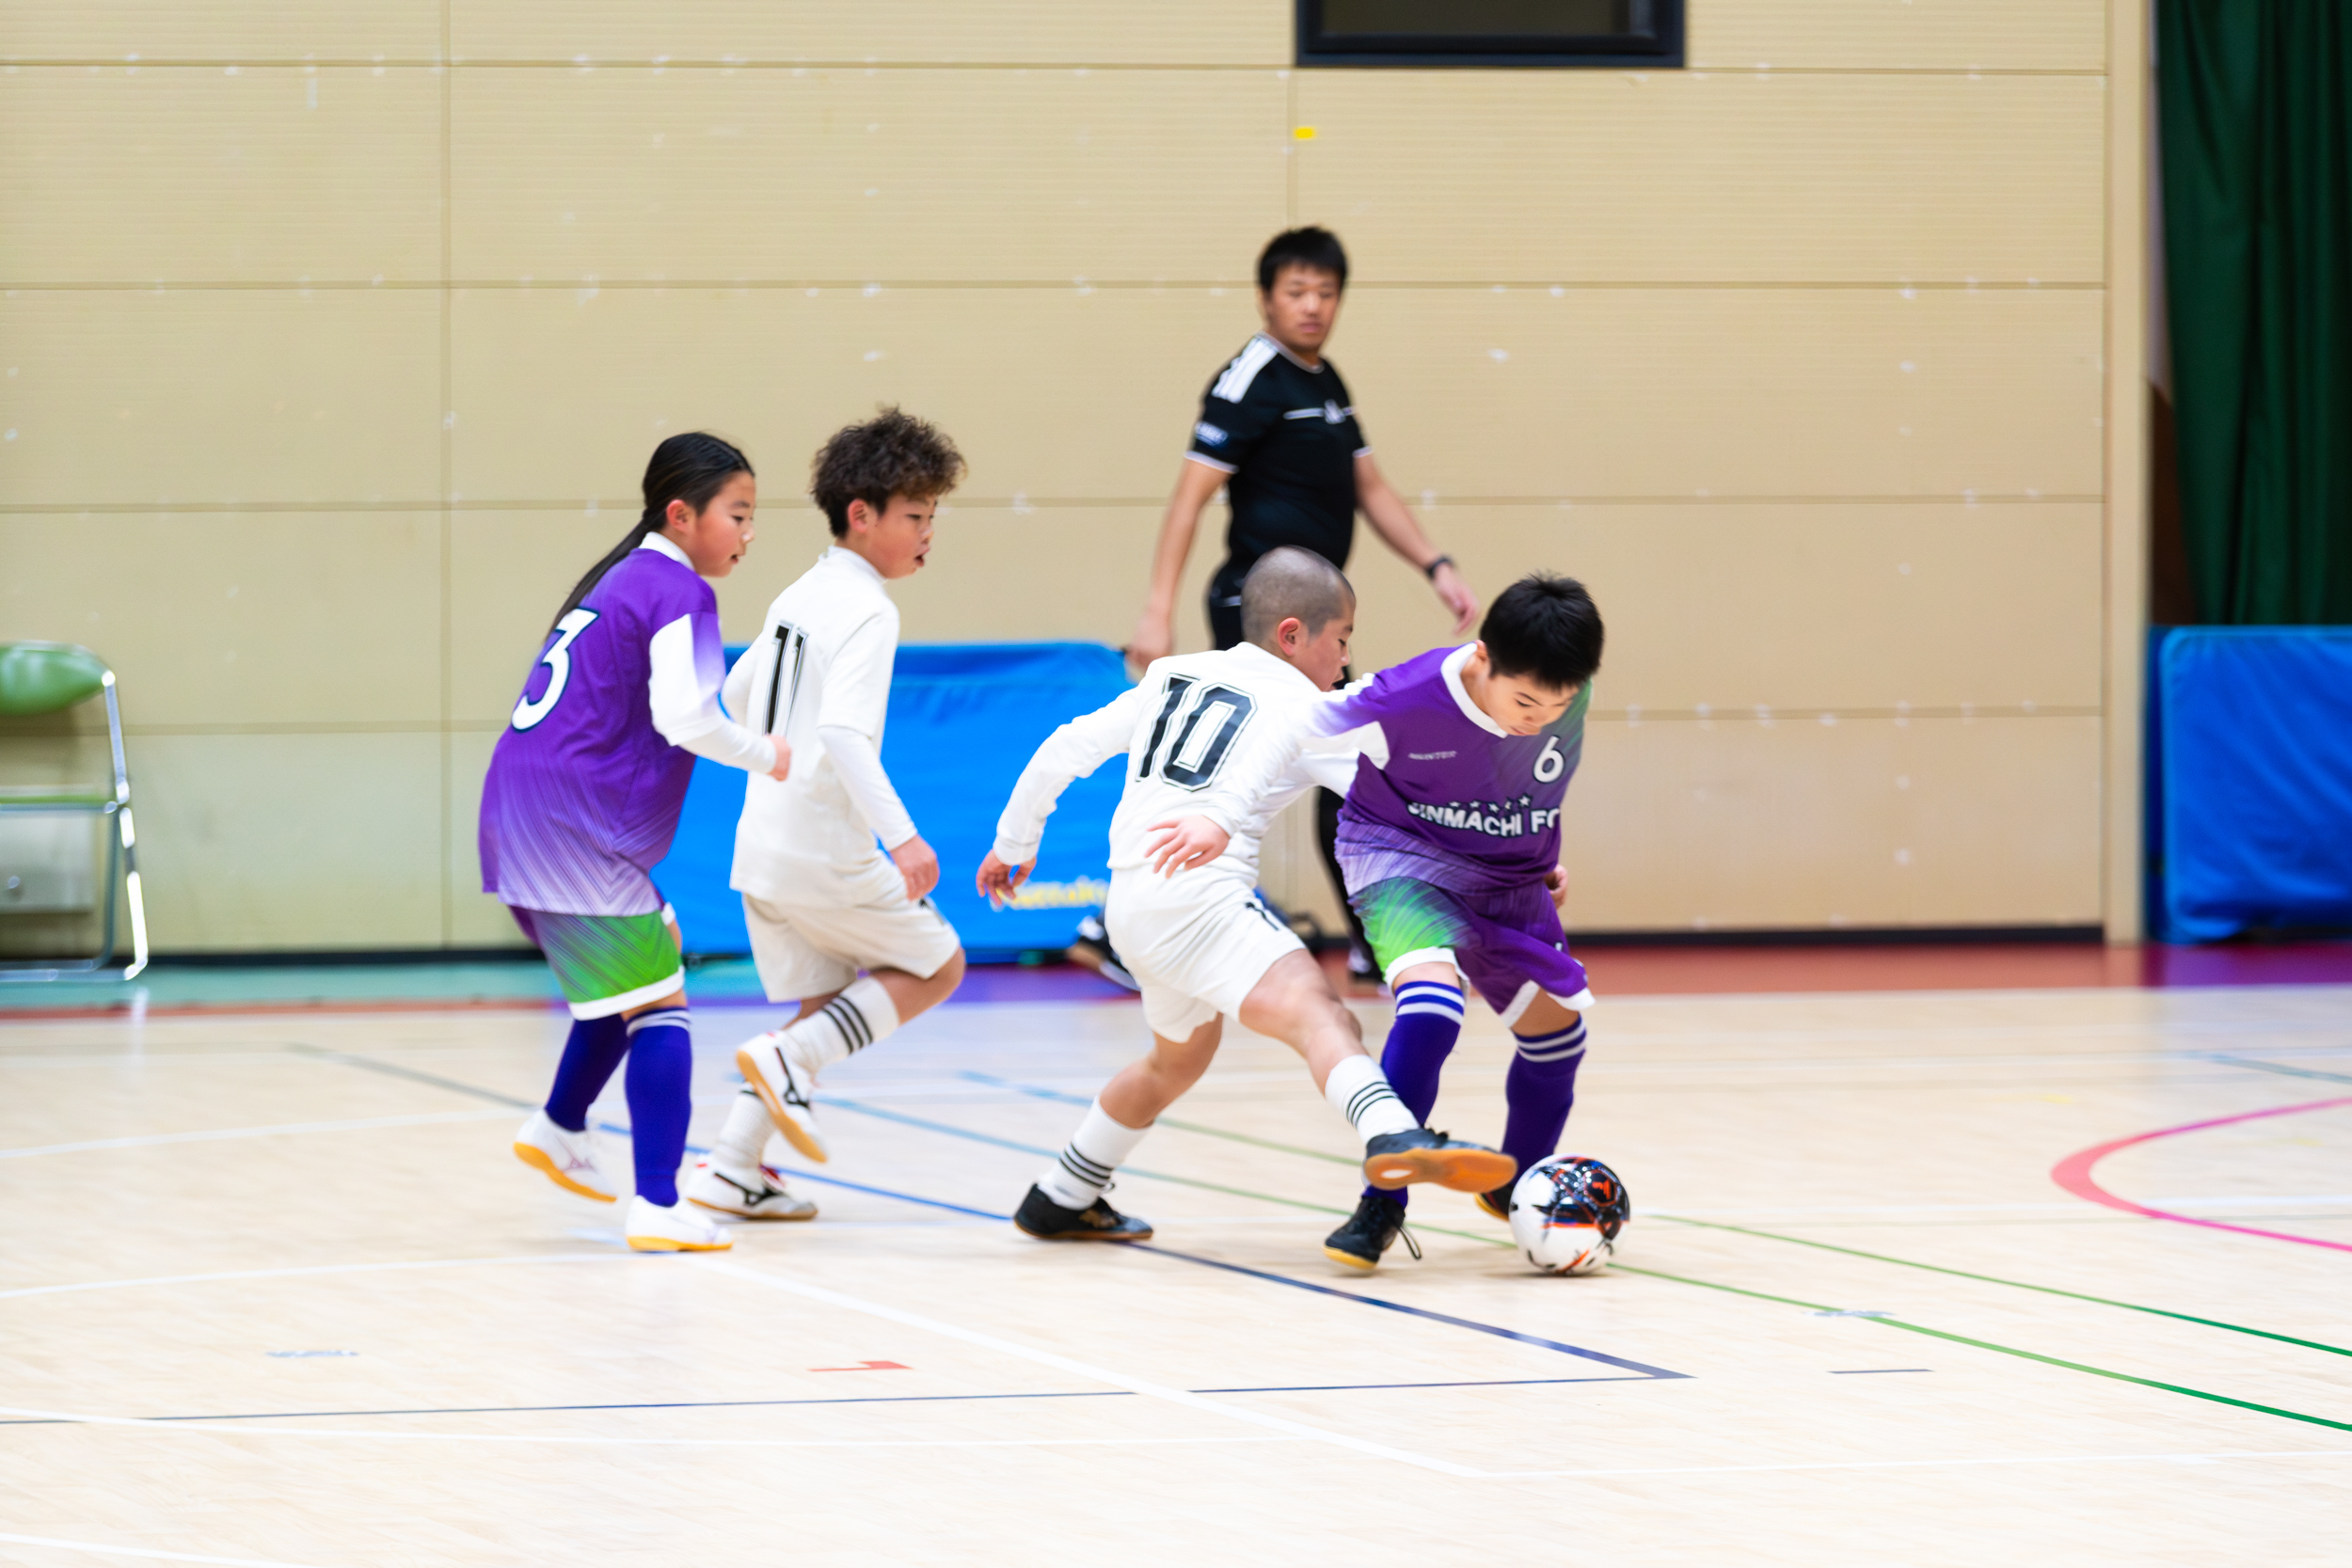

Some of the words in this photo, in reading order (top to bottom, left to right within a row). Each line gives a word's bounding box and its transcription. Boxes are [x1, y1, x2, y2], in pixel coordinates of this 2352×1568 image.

[511, 606, 600, 734] 3
[761, 620, 809, 736] 11
[1135, 673, 1259, 792] 10
[1533, 735, 1565, 784] 6
